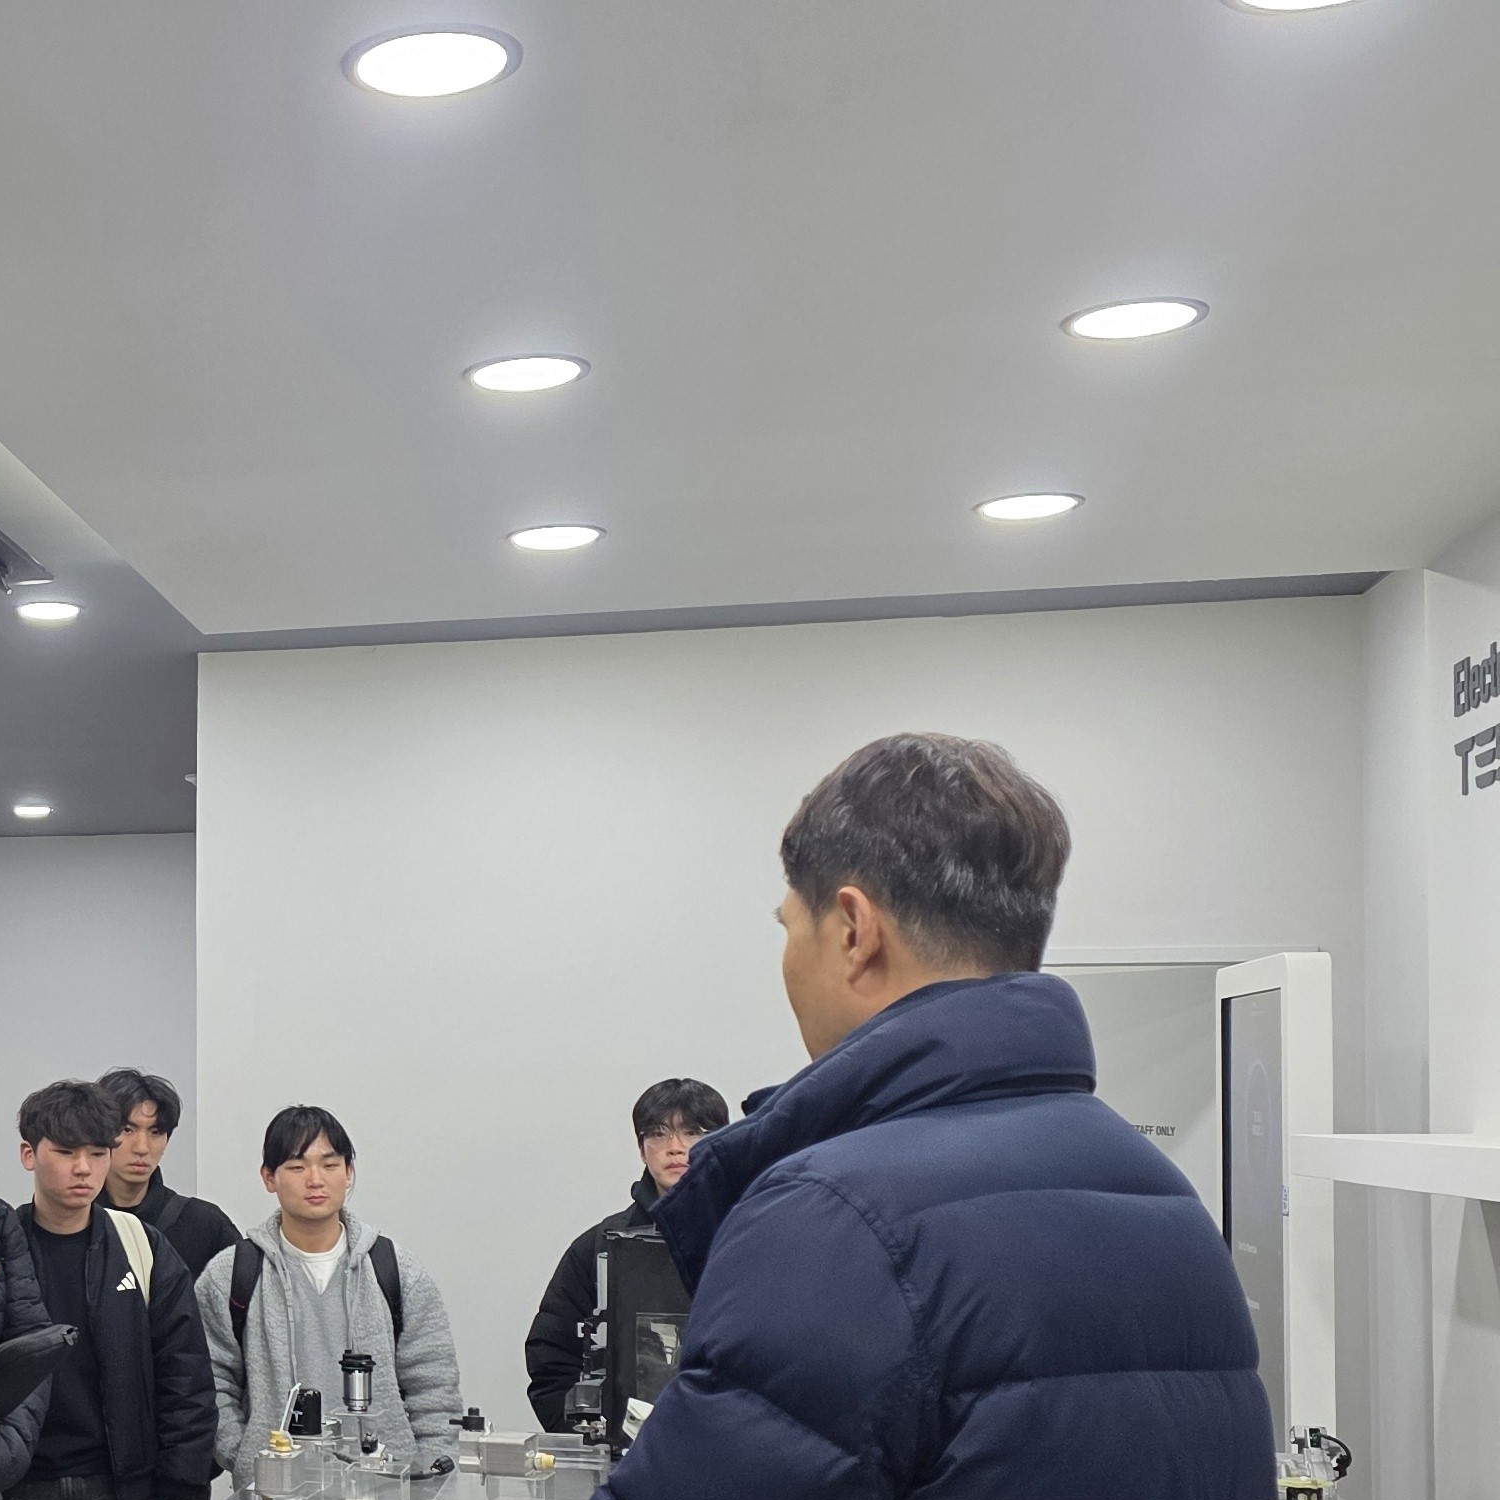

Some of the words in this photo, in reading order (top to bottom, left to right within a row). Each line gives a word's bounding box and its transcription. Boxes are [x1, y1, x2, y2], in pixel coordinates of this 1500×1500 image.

[1454, 642, 1500, 718] Elect
[1454, 722, 1500, 796] TE
[1132, 1124, 1155, 1136] TAFF
[1155, 1125, 1176, 1137] ONLY
